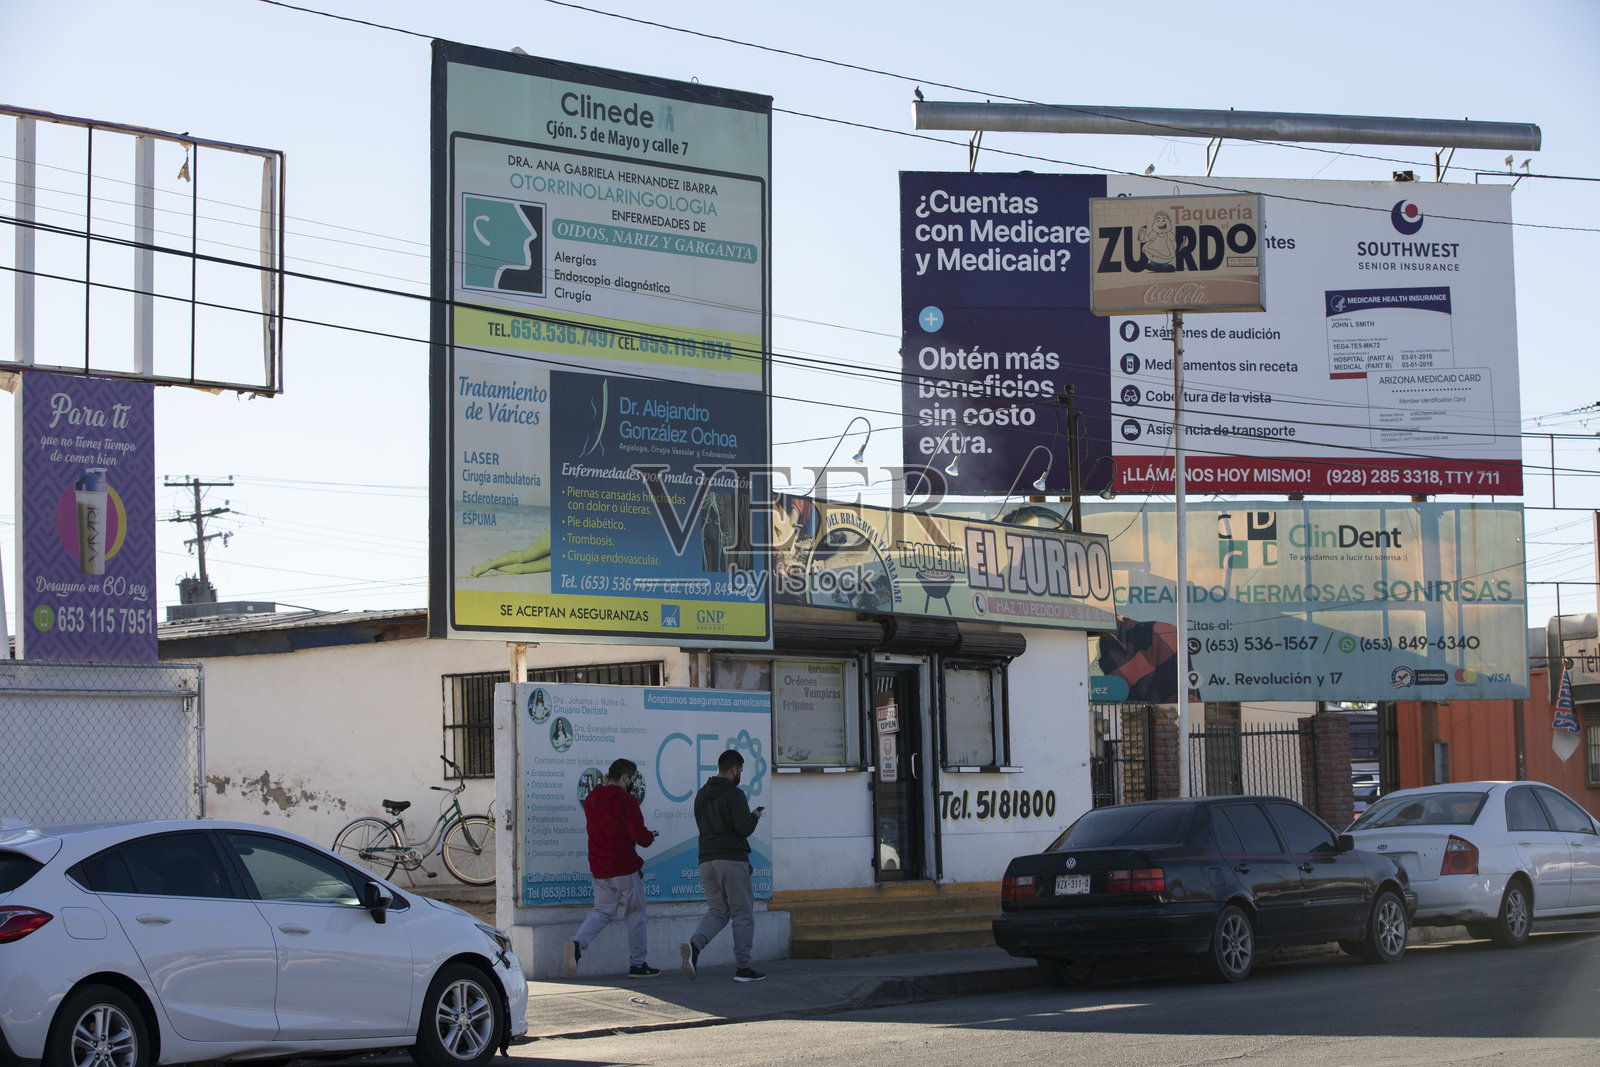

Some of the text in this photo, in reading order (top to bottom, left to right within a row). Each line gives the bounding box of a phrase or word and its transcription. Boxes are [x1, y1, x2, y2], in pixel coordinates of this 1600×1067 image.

[561, 92, 654, 128] Clinede
[547, 120, 688, 155] Cjón. 5 de Mayo y calle 7
[508, 155, 718, 195] DRA. ANA GABRIELA HERNANDEZ IBARRA
[510, 173, 717, 216] OTORRINOLARINGOLOGIA
[916, 190, 1038, 218] ¿Cuentas
[612, 210, 706, 233] ENFERMEDADES DE
[1170, 204, 1252, 224] Taquería
[916, 220, 1090, 244] con Medicare
[557, 222, 753, 260] OIDOS, NARIZ Y GARGANTA
[1097, 223, 1256, 273] ZURDO
[1357, 242, 1459, 257] SOUTHWEST
[554, 252, 596, 268] Alergías
[915, 248, 1071, 275] y Medicaid?
[1359, 262, 1460, 271] SENIOR INSURANCE
[554, 269, 670, 294] Endoscopia diagnóstica
[554, 287, 592, 303] Cirugía
[1409, 294, 1446, 302] INSURANCE
[1210, 328, 1280, 339] de audición
[919, 346, 1060, 370] Obtén más
[1239, 360, 1298, 372] sin receta
[919, 374, 1054, 398] beneficios
[1379, 374, 1481, 384] ARIZONA MEDICAID CARD
[459, 376, 547, 402] Tratamiento
[1211, 392, 1272, 403] de la vista
[50, 392, 109, 428] Para
[466, 402, 540, 425] de Várices
[620, 397, 709, 422] Dr. Alejandro
[919, 403, 1035, 426] sin costo
[620, 420, 738, 448] González Ochoa
[1214, 425, 1295, 438] de transporte
[41, 436, 136, 452] que no tiempo
[919, 432, 992, 454] extra.
[50, 452, 117, 466] de comer bien
[464, 451, 499, 465] LASER
[462, 469, 540, 486] Cirugía ambulatoria
[562, 463, 752, 489] Enfermedades circulación
[1217, 468, 1311, 482] HOY MISMO!
[1327, 470, 1500, 486] (928) 285 3318, TTY 711
[463, 491, 519, 507] Escleroterapia
[568, 486, 640, 501] Piernas cansadas
[587, 500, 610, 512] dolor
[620, 502, 652, 515] úlceras.
[463, 512, 496, 526] ESPUMA
[568, 516, 626, 530] Pie diabético.
[568, 533, 615, 546] Trombosis.
[1289, 524, 1402, 548] ClinDent
[568, 550, 660, 566] Cirugía endovascular.
[896, 540, 965, 573] TAQUERÍA
[965, 527, 1110, 600] EL ZURDO
[103, 576, 126, 596] 60
[561, 575, 631, 591] Tel. (653) 536
[1236, 580, 1512, 602] HERMOSAS SONRISAS
[501, 605, 649, 622] SE ACEPTAN ASEGURANZAS
[697, 610, 724, 623] GNP
[1031, 603, 1060, 617] PEDIDO
[58, 606, 153, 634] 653 115 7951
[662, 617, 676, 626] AXA
[1187, 620, 1214, 631] Citas
[1206, 636, 1480, 654] (653) 536-1567 (653) 849-6340
[1208, 672, 1342, 686] Av. Revolución y 17
[1487, 672, 1511, 683] VISA
[648, 694, 732, 707] Aceptamos aseguranzas
[804, 688, 840, 700] Vampiras
[554, 705, 608, 715] Cirujano Dentista
[881, 721, 896, 729] OPEN
[939, 789, 1056, 820] Tel. 5181800
[528, 888, 539, 898] Tel
